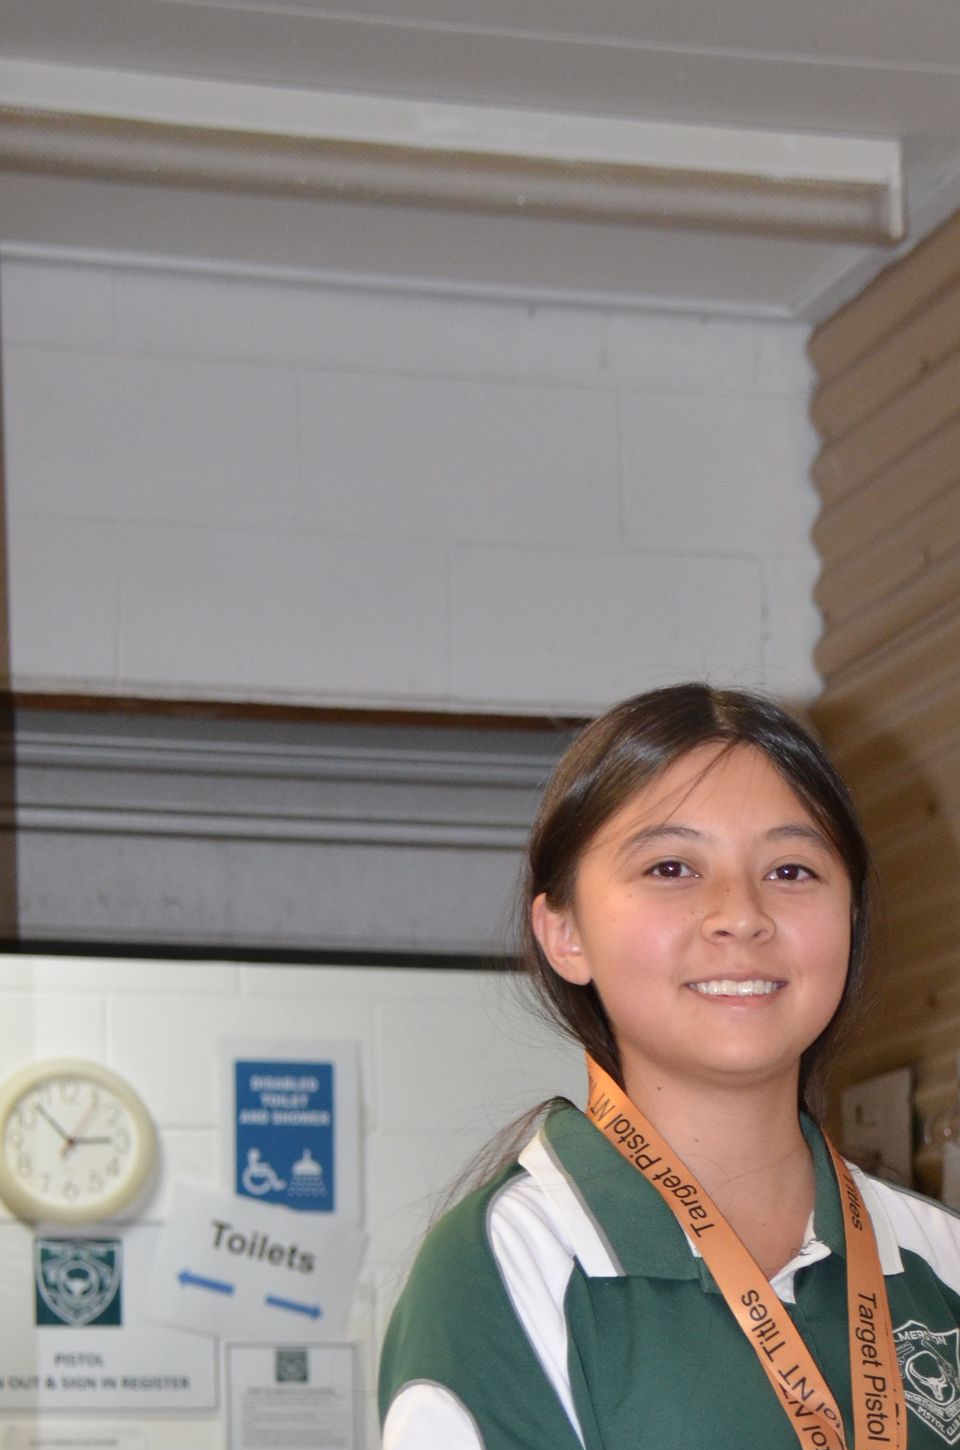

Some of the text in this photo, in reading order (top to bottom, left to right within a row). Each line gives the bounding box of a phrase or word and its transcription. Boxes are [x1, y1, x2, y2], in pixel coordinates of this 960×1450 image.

[250, 1075, 319, 1093] DISABLED
[259, 1093, 310, 1109] TOILET
[239, 1109, 330, 1126] AND SHOWER
[604, 1113, 663, 1171] Pistol
[652, 1167, 715, 1238] Target
[211, 1219, 316, 1274] Toilets
[741, 1289, 816, 1401] NT Titles
[855, 1293, 882, 1368] Target
[54, 1352, 104, 1367] PISTOL
[8, 1377, 38, 1391] OUT
[62, 1377, 96, 1391] SIGN
[103, 1377, 117, 1391] IN
[122, 1377, 190, 1391] REGISTER
[863, 1374, 891, 1442] Pistol
[917, 1405, 946, 1433] PISTOL
